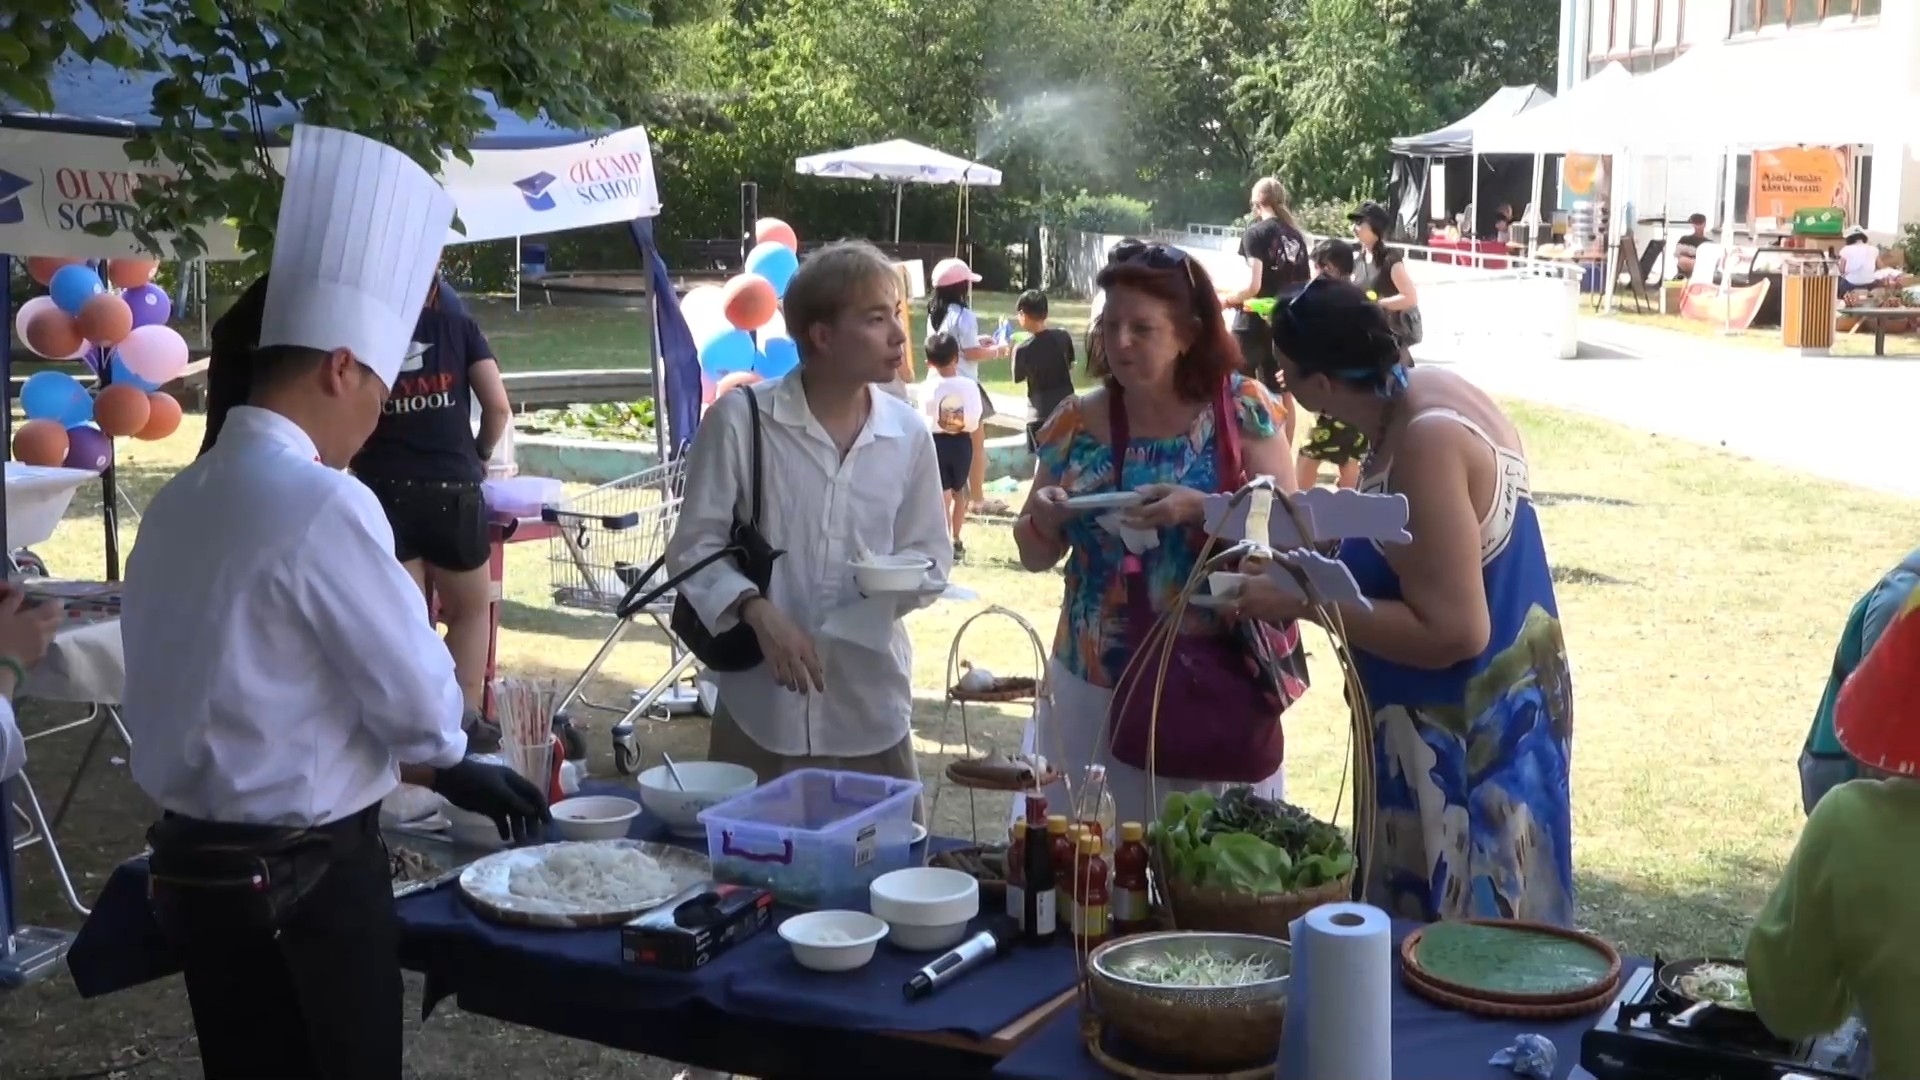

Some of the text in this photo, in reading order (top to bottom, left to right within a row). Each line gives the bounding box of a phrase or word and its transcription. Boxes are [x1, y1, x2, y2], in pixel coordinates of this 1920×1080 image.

[570, 151, 642, 184] OLYMP
[400, 372, 454, 395] YMP
[382, 391, 456, 416] CHOOL
